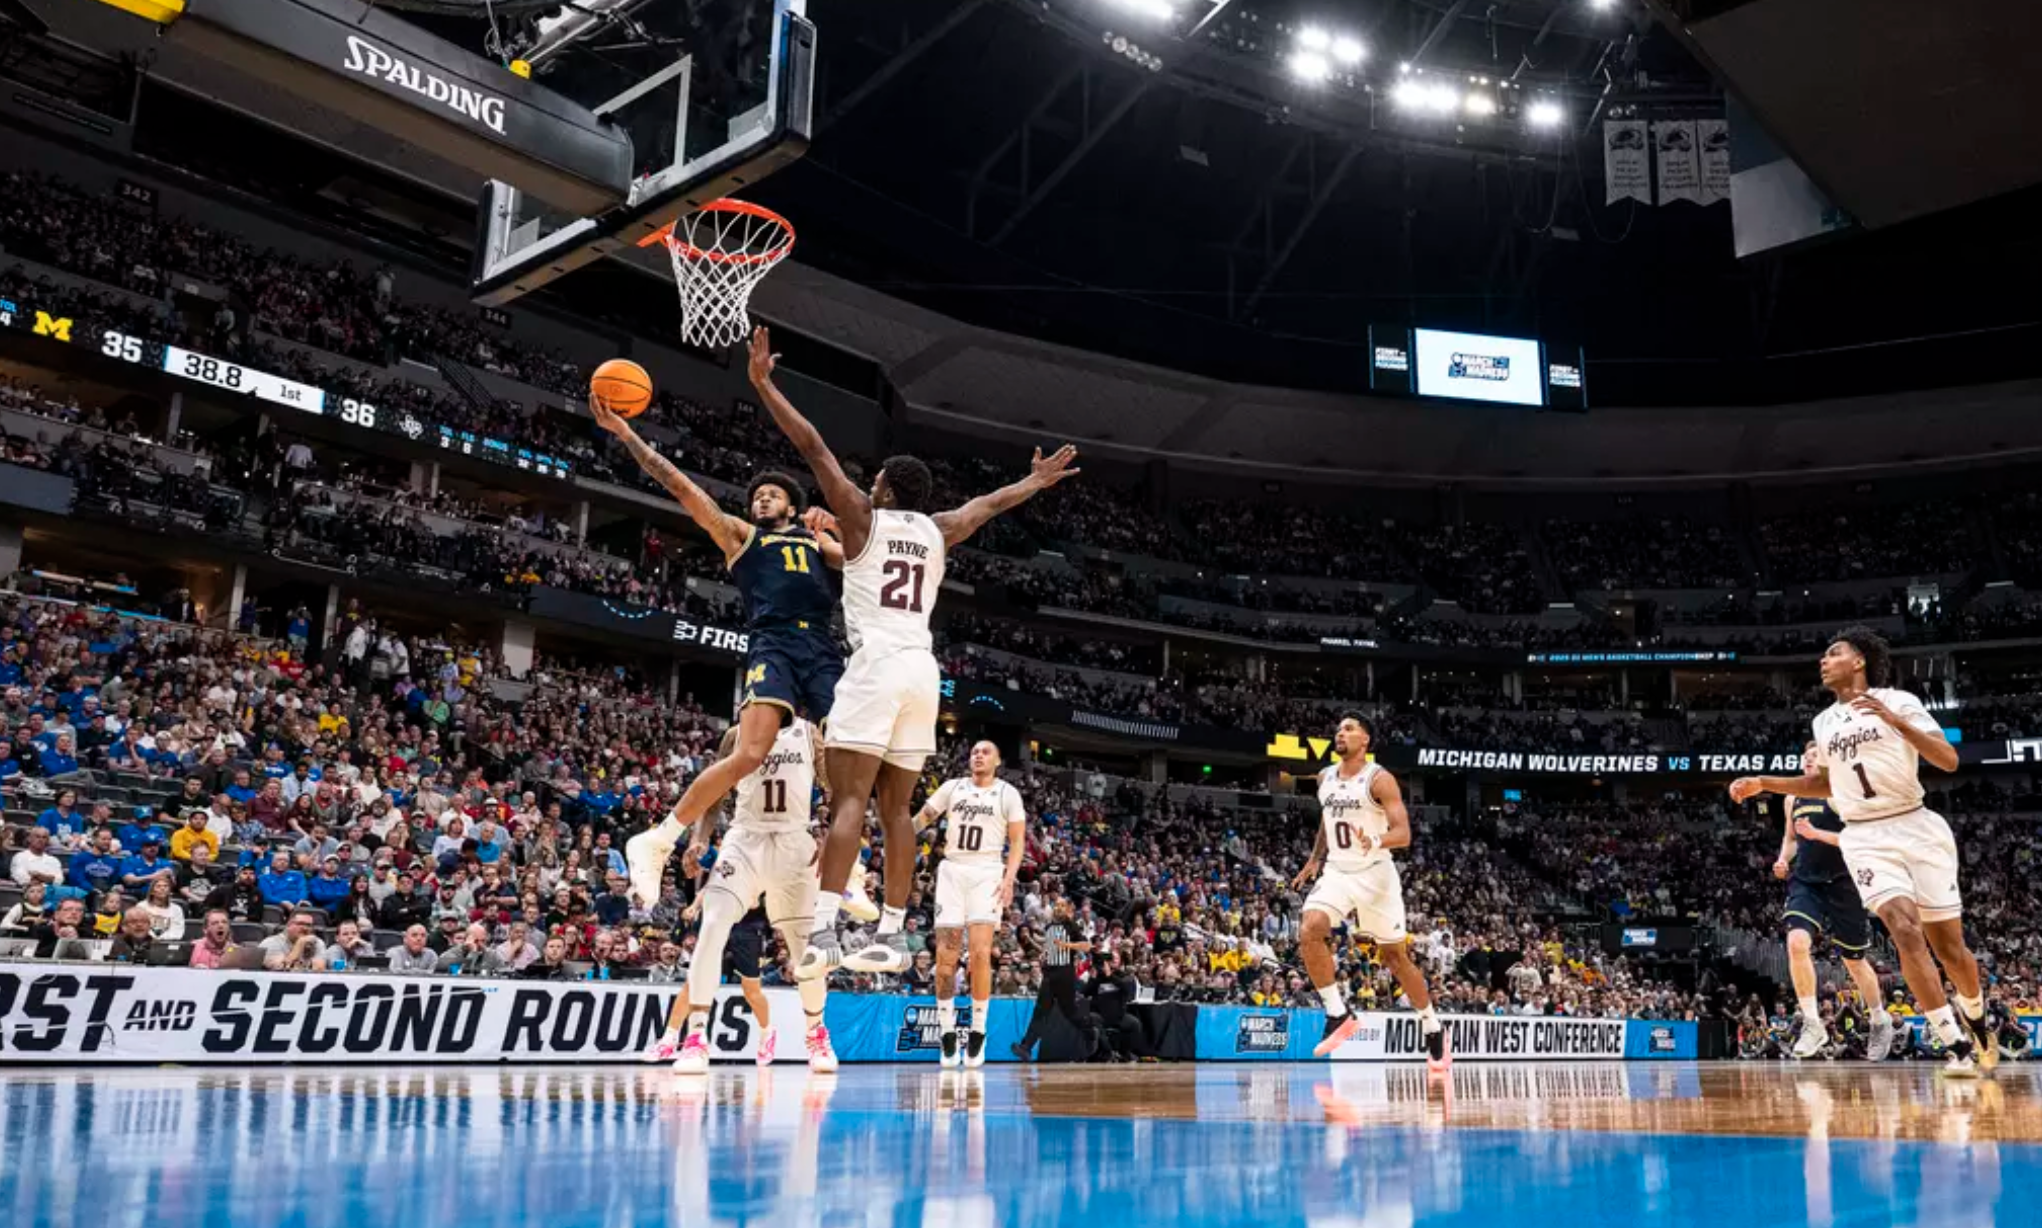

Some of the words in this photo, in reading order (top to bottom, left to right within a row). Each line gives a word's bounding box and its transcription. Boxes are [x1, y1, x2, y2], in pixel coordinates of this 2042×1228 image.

[344, 35, 507, 136] SPALDING
[123, 183, 150, 201] 342
[32, 310, 74, 342] M
[102, 330, 143, 363] 35
[184, 353, 242, 388] 38.8
[279, 384, 302, 402] 1st
[341, 398, 375, 428] 36
[781, 546, 809, 574] 11
[887, 540, 929, 560] PAYNE
[880, 559, 925, 614] 21
[700, 626, 749, 653] FIRS
[1828, 727, 1882, 761] Aggies
[760, 748, 804, 775] ggies
[1418, 749, 1523, 770] MICHIGAN
[1528, 754, 1658, 772] WOLVERINES
[1668, 757, 1690, 770] VS
[1699, 754, 1764, 771] TEXAS
[1769, 754, 1805, 771] A&
[1852, 762, 1876, 799] 1
[762, 780, 787, 812] 11
[952, 800, 995, 821] Aggies
[958, 824, 983, 851] 10
[1335, 822, 1351, 849] 0
[123, 999, 197, 1031] AND
[201, 979, 487, 1053] SECOND
[502, 989, 752, 1052] ROUNS
[1247, 1017, 1274, 1031] MARCH
[1384, 1018, 1479, 1053] MOUTAIN
[1485, 1020, 1529, 1054] WEST
[1533, 1022, 1622, 1054] CONFERENCE
